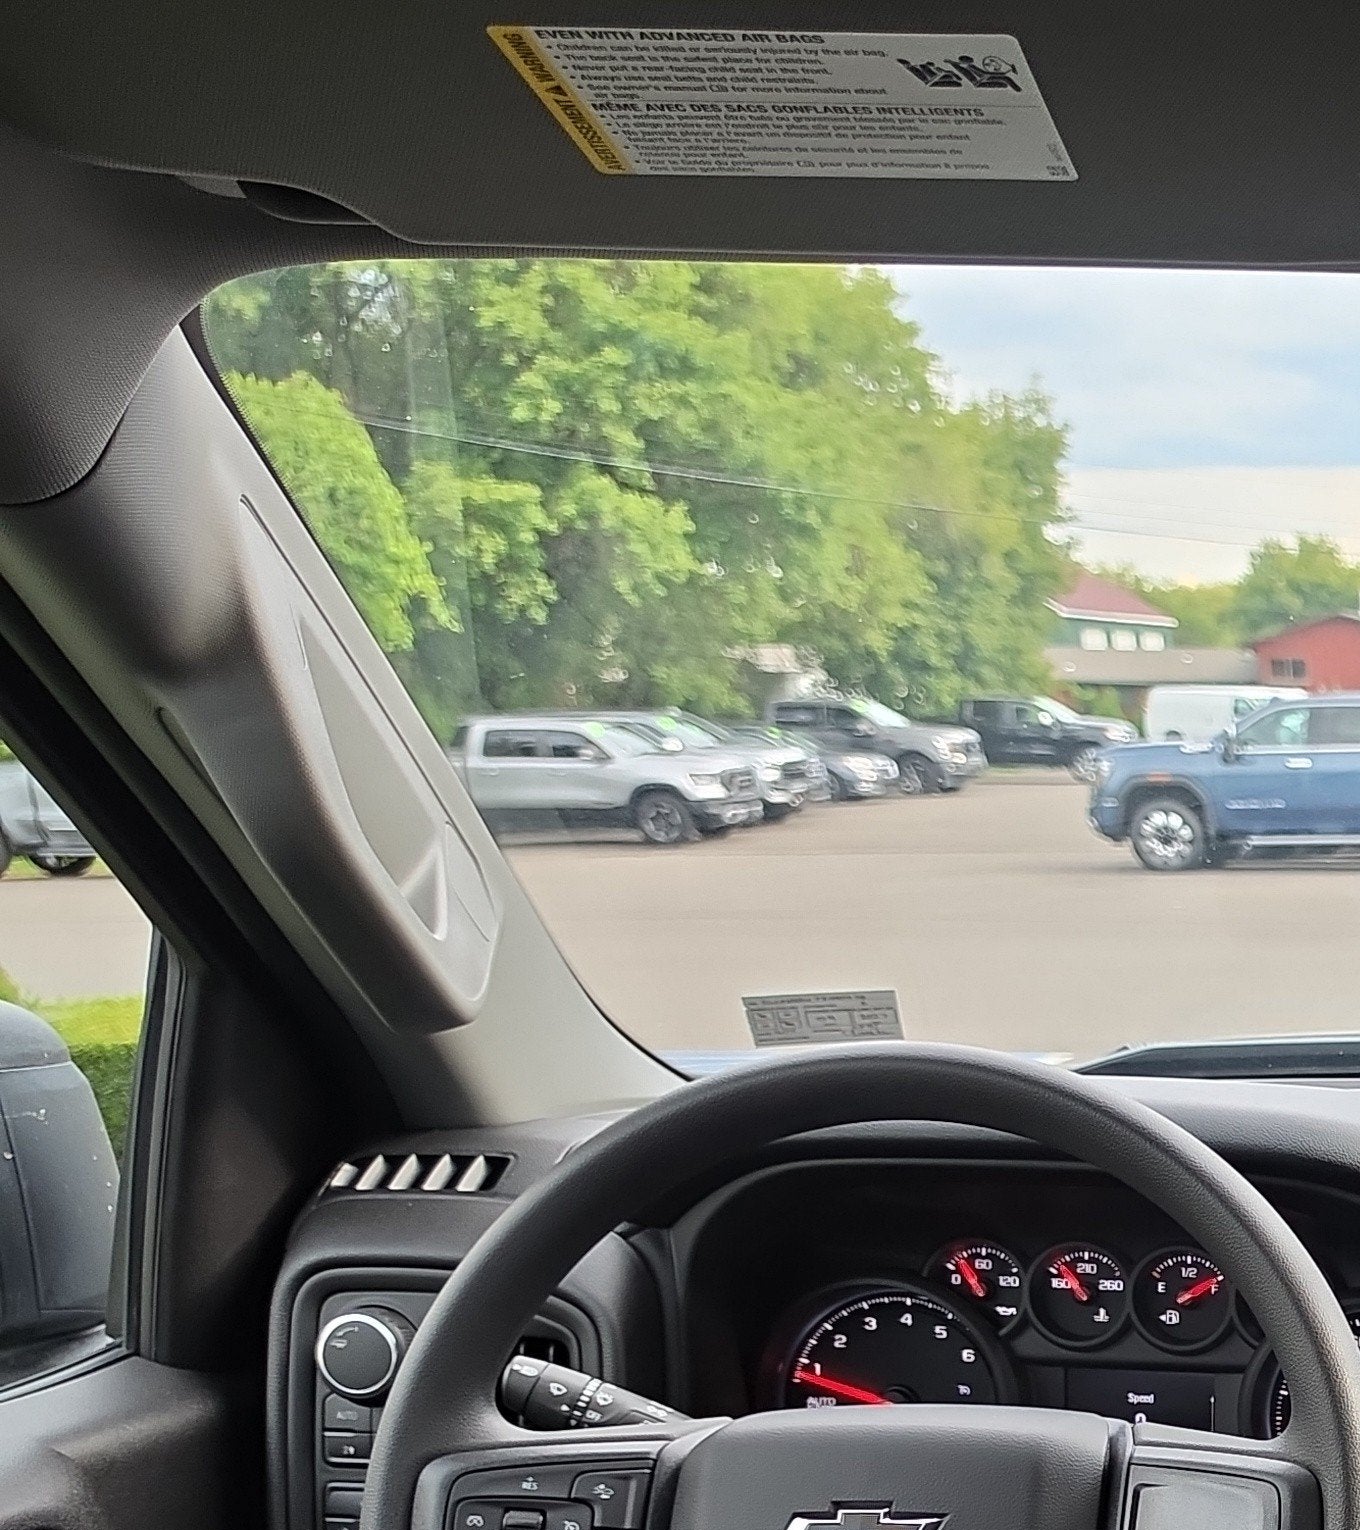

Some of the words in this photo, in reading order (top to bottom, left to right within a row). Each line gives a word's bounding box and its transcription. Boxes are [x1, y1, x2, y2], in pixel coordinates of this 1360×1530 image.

[535, 30, 584, 40] EVEN
[585, 31, 634, 40] WITH
[639, 31, 735, 42] ADVANCED
[742, 33, 772, 43] AIR
[775, 34, 825, 44] BAGS
[503, 33, 557, 85] WARNING
[590, 101, 640, 112] MÊME
[645, 103, 687, 113] AVEC
[689, 103, 723, 113] DES
[724, 103, 769, 114] SACS
[770, 104, 873, 116] GONFLABLES
[876, 106, 985, 118] INTELLIGENTS
[974, 1258, 993, 1271] 60
[1075, 1263, 1098, 1275] 210
[950, 1272, 961, 1285] 0
[1179, 1266, 1198, 1279] 1/2
[998, 1275, 1020, 1288] 120
[1098, 1279, 1124, 1292] 260
[1157, 1281, 1166, 1293] E
[1209, 1283, 1220, 1295] F
[861, 1316, 878, 1331] 3
[899, 1312, 914, 1327] 4
[933, 1324, 948, 1339] 5
[832, 1333, 848, 1349] 2
[961, 1347, 976, 1363] 6
[813, 1362, 821, 1376] 1
[1126, 1391, 1155, 1406] Speed
